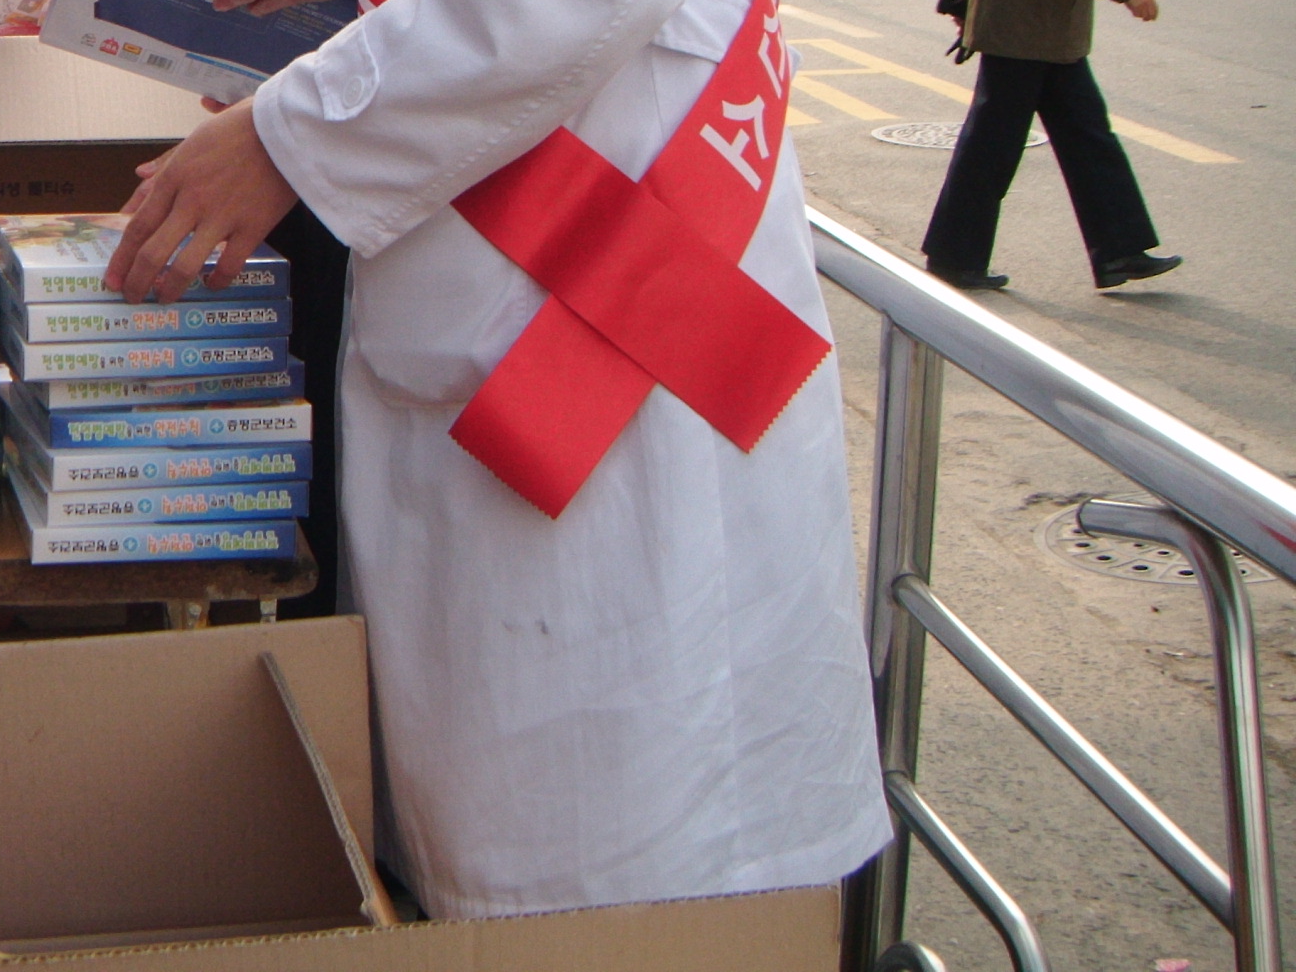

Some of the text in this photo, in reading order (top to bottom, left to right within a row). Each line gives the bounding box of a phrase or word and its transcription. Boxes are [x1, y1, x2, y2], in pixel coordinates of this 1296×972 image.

[205, 309, 277, 325] 증평군보건소
[201, 347, 274, 363] 증평군보건소
[227, 416, 298, 432] 증평군보건소
